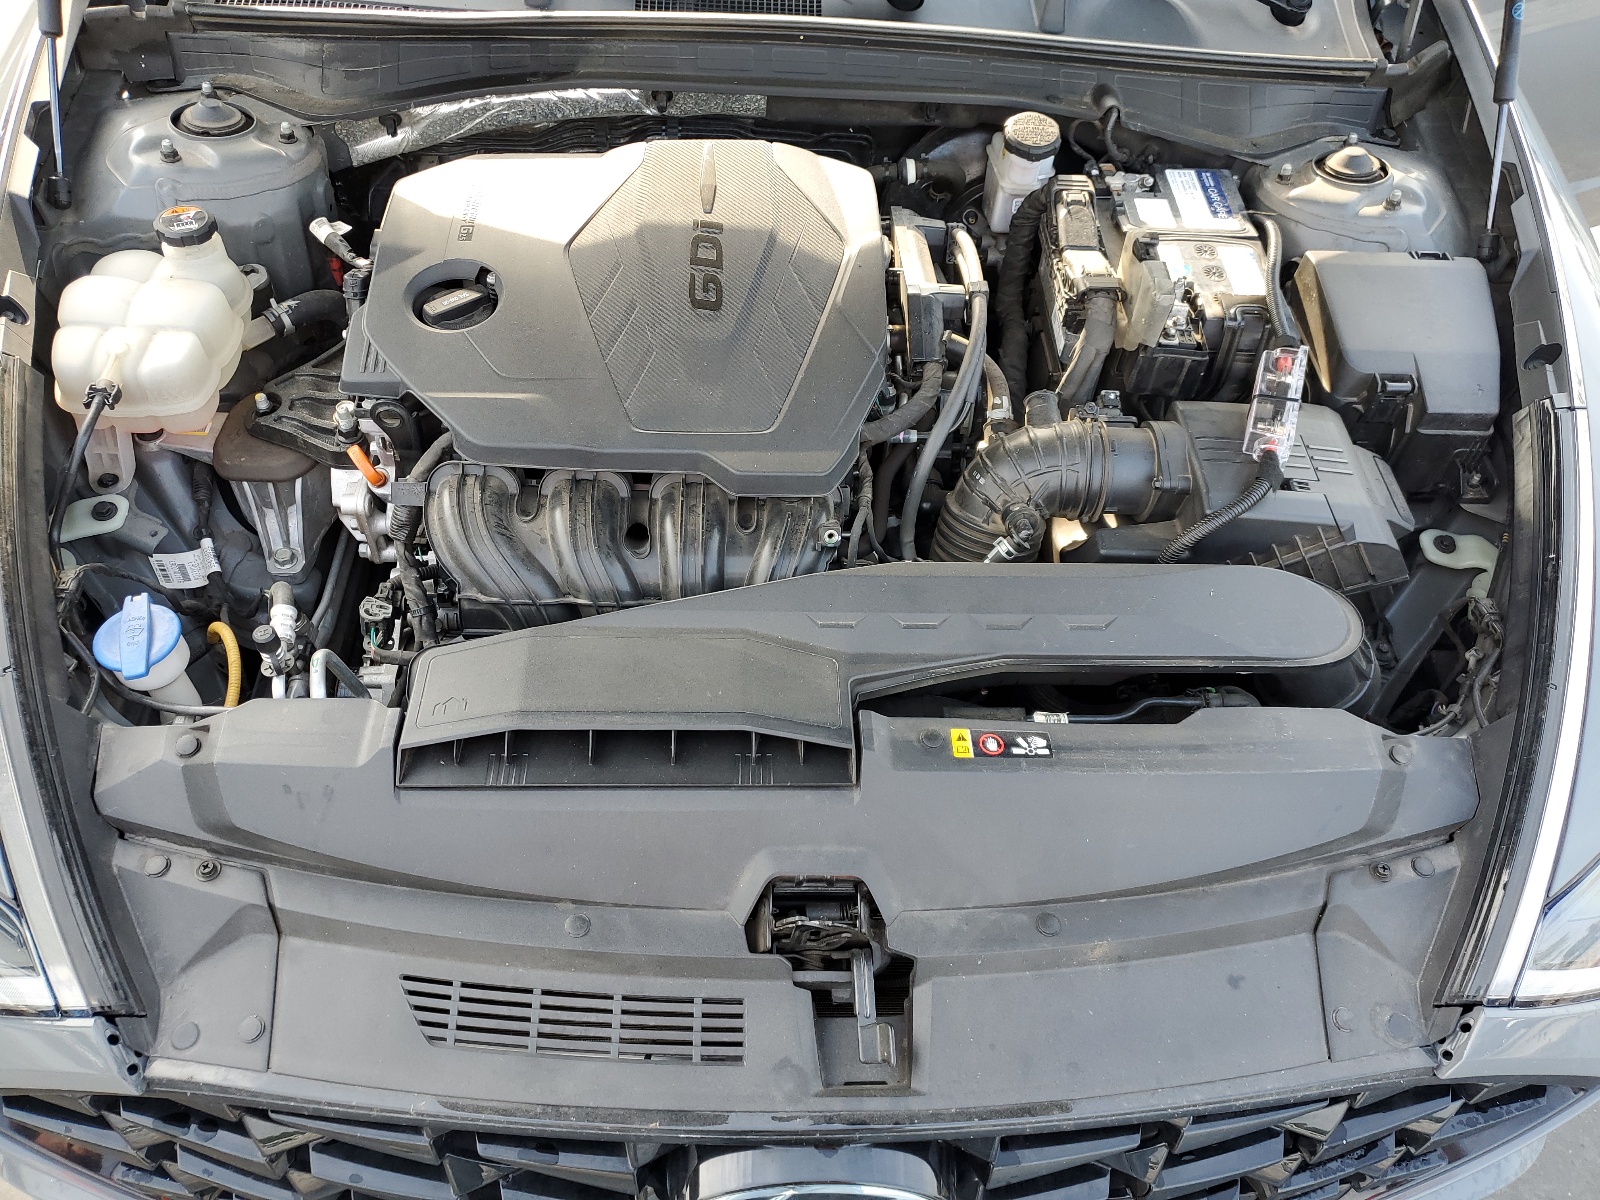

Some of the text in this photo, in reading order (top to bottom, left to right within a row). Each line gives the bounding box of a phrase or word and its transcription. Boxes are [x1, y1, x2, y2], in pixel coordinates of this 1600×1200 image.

[1207, 188, 1220, 201] CAR
[1213, 201, 1228, 219] CARE
[688, 219, 723, 312] GDi
